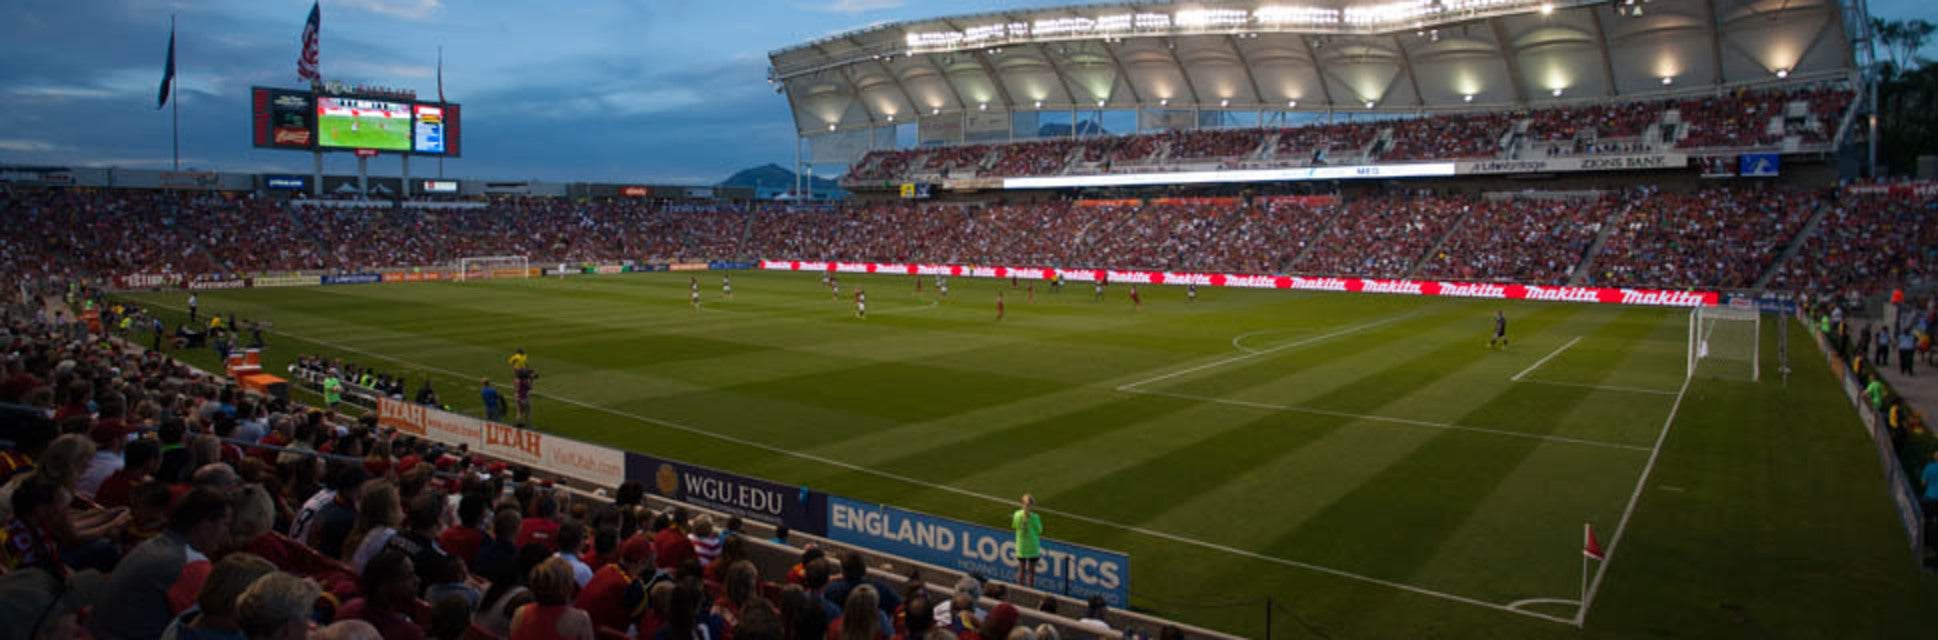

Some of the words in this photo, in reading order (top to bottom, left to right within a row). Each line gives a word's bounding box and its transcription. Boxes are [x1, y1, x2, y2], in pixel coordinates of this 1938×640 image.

[1581, 158, 1622, 169] ZIONS
[1627, 156, 1664, 167] BANK
[380, 397, 425, 427] UTAH
[486, 423, 542, 458] UTAH
[684, 472, 784, 515] WGU.EDU
[831, 502, 956, 552] ENGLAND
[962, 532, 1121, 590] LOGSTICS
